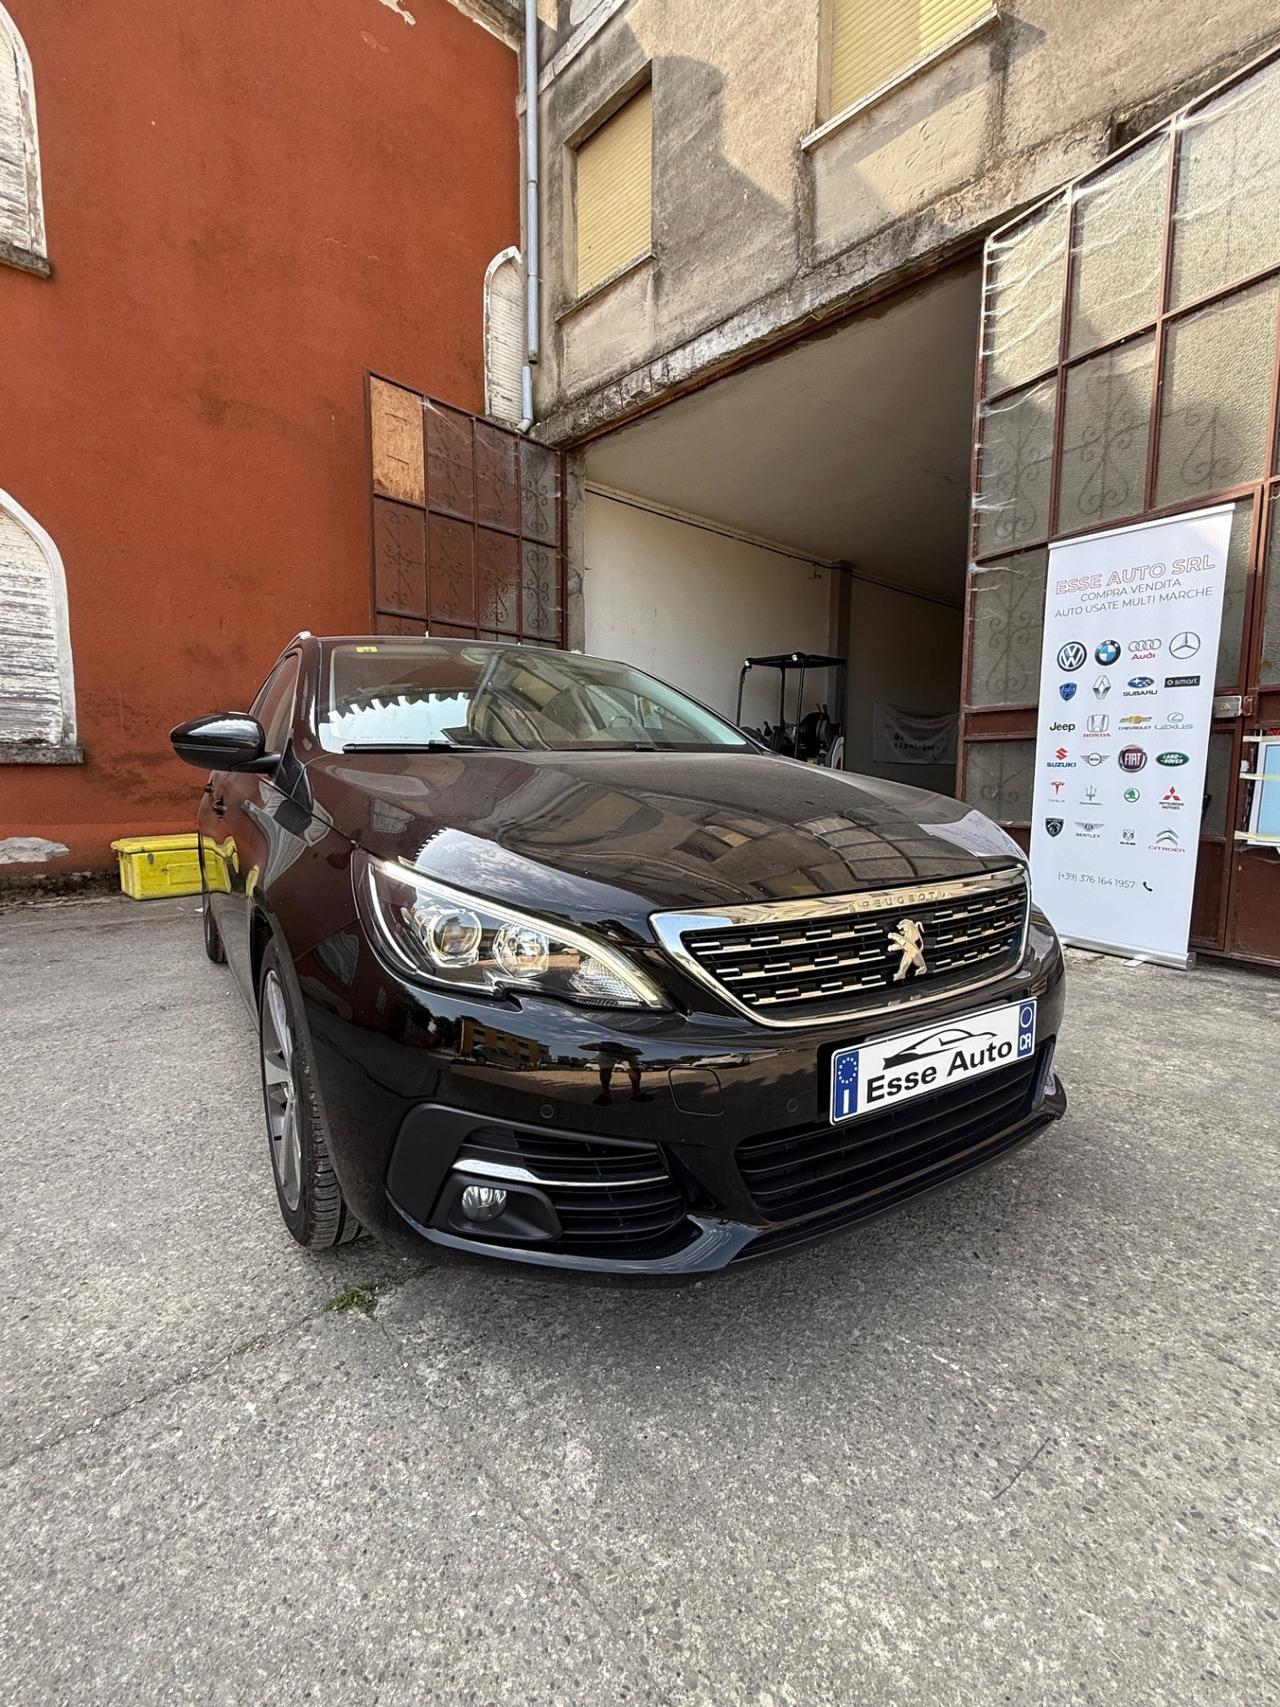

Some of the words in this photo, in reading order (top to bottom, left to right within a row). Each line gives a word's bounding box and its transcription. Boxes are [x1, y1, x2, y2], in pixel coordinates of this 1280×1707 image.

[1055, 573, 1102, 595] ESSE
[1106, 562, 1166, 587] AUTO
[1171, 554, 1216, 575] SRL
[1080, 587, 1128, 602] COMPRA
[1130, 577, 1182, 594] VENDITA
[1054, 606, 1083, 618] AUTO
[1085, 601, 1120, 614] USATE
[1122, 596, 1156, 609] MULTI
[1159, 586, 1213, 603] MARCHE
[1131, 652, 1156, 660] Audi
[1173, 677, 1198, 686] smart
[1122, 689, 1158, 697] SUBARU
[1049, 721, 1076, 733] Jeep
[1124, 752, 1142, 766] FIAT
[1058, 871, 1077, 882] (+39)
[1079, 875, 1096, 884] 376
[1097, 876, 1112, 886] 164
[1115, 878, 1136, 889] 1957
[862, 891, 936, 910] PEUGEOT
[1019, 1033, 1032, 1050] CR
[866, 1065, 937, 1104] Esse
[946, 1040, 1013, 1077] Auto
